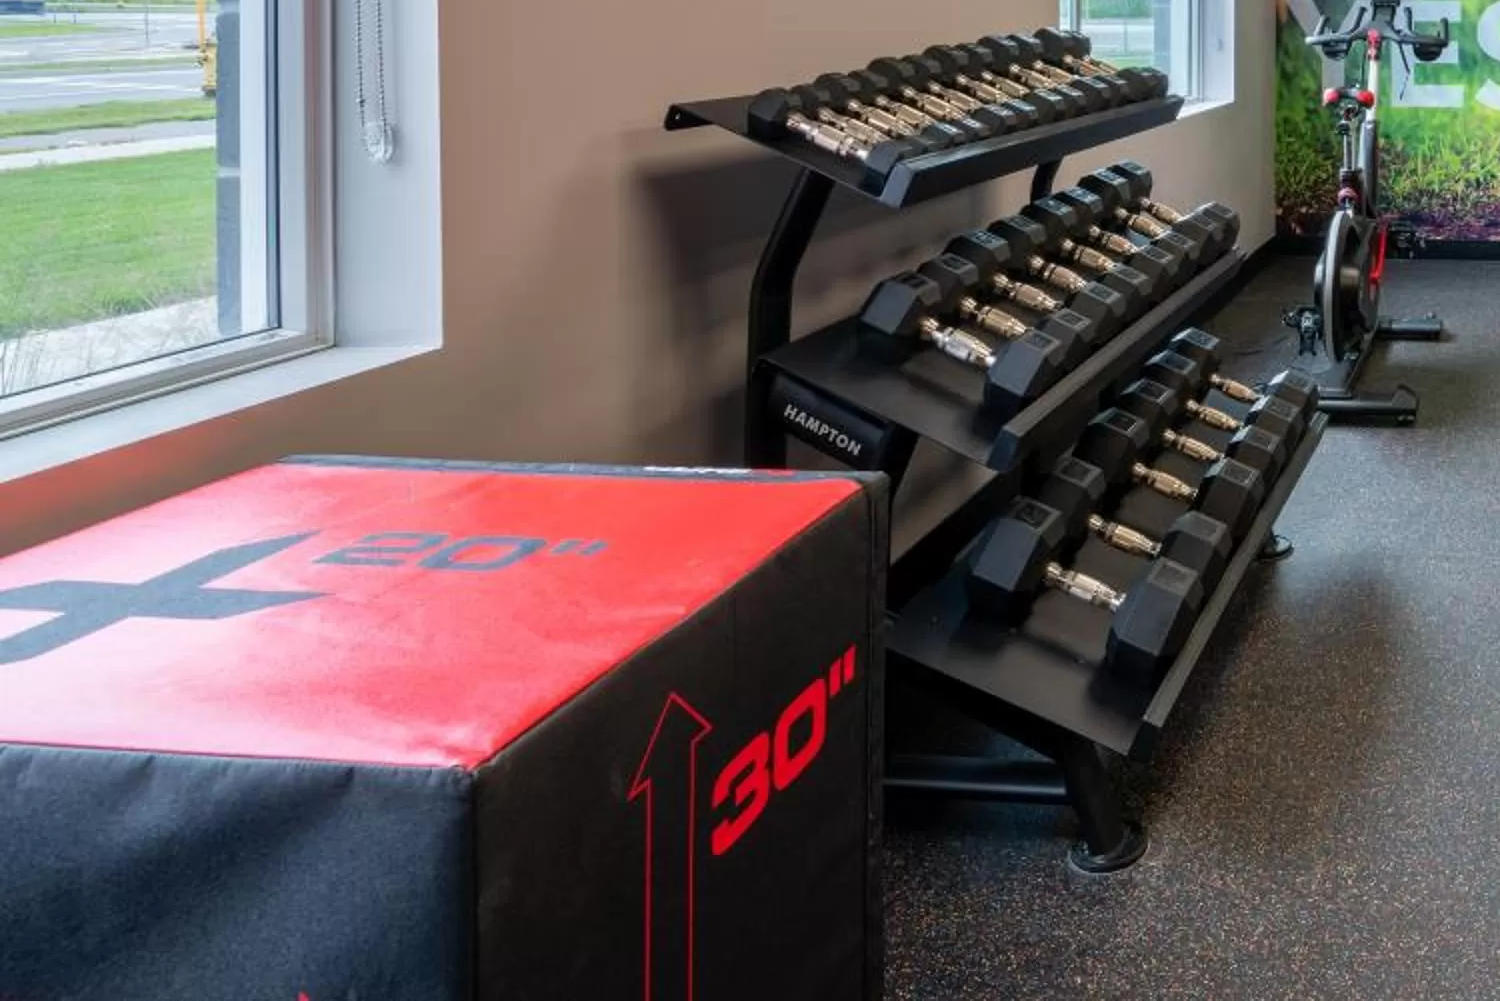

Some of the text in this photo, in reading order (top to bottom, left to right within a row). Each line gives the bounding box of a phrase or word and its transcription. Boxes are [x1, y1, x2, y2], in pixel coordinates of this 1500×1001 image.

[783, 404, 862, 456] HAMPTON
[311, 531, 609, 573] 20"
[711, 643, 857, 857] 30"
